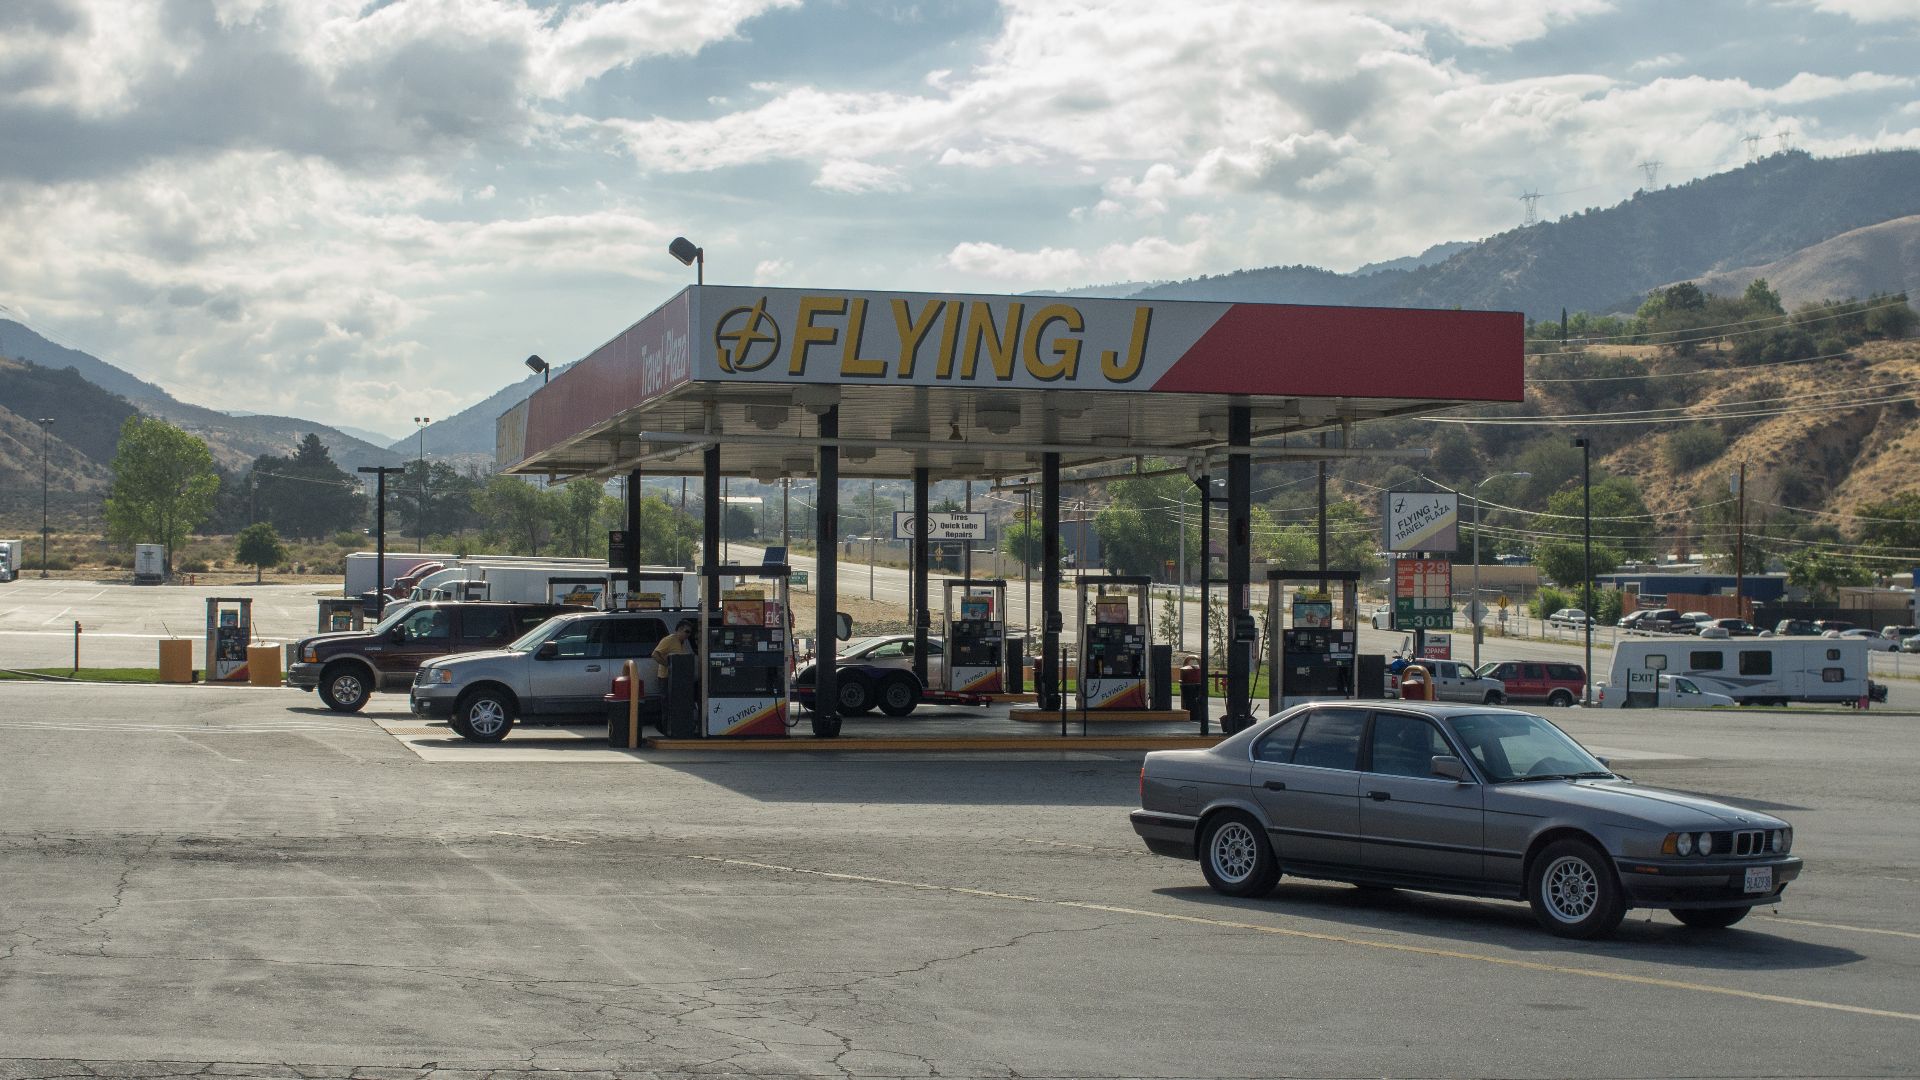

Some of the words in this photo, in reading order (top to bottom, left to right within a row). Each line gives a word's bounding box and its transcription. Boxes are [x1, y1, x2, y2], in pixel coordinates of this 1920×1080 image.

[789, 296, 1085, 381] FLYING
[1101, 305, 1153, 383] J
[641, 335, 664, 397] Travel
[664, 328, 687, 385] Plaza
[1395, 521, 1425, 540] TRAVEL
[1425, 504, 1450, 524] PLAZA
[1397, 505, 1430, 530] FLYING
[1433, 498, 1439, 509] J
[1631, 673, 1654, 682] EXIT
[728, 705, 757, 725] FLYING
[757, 701, 763, 709] J
